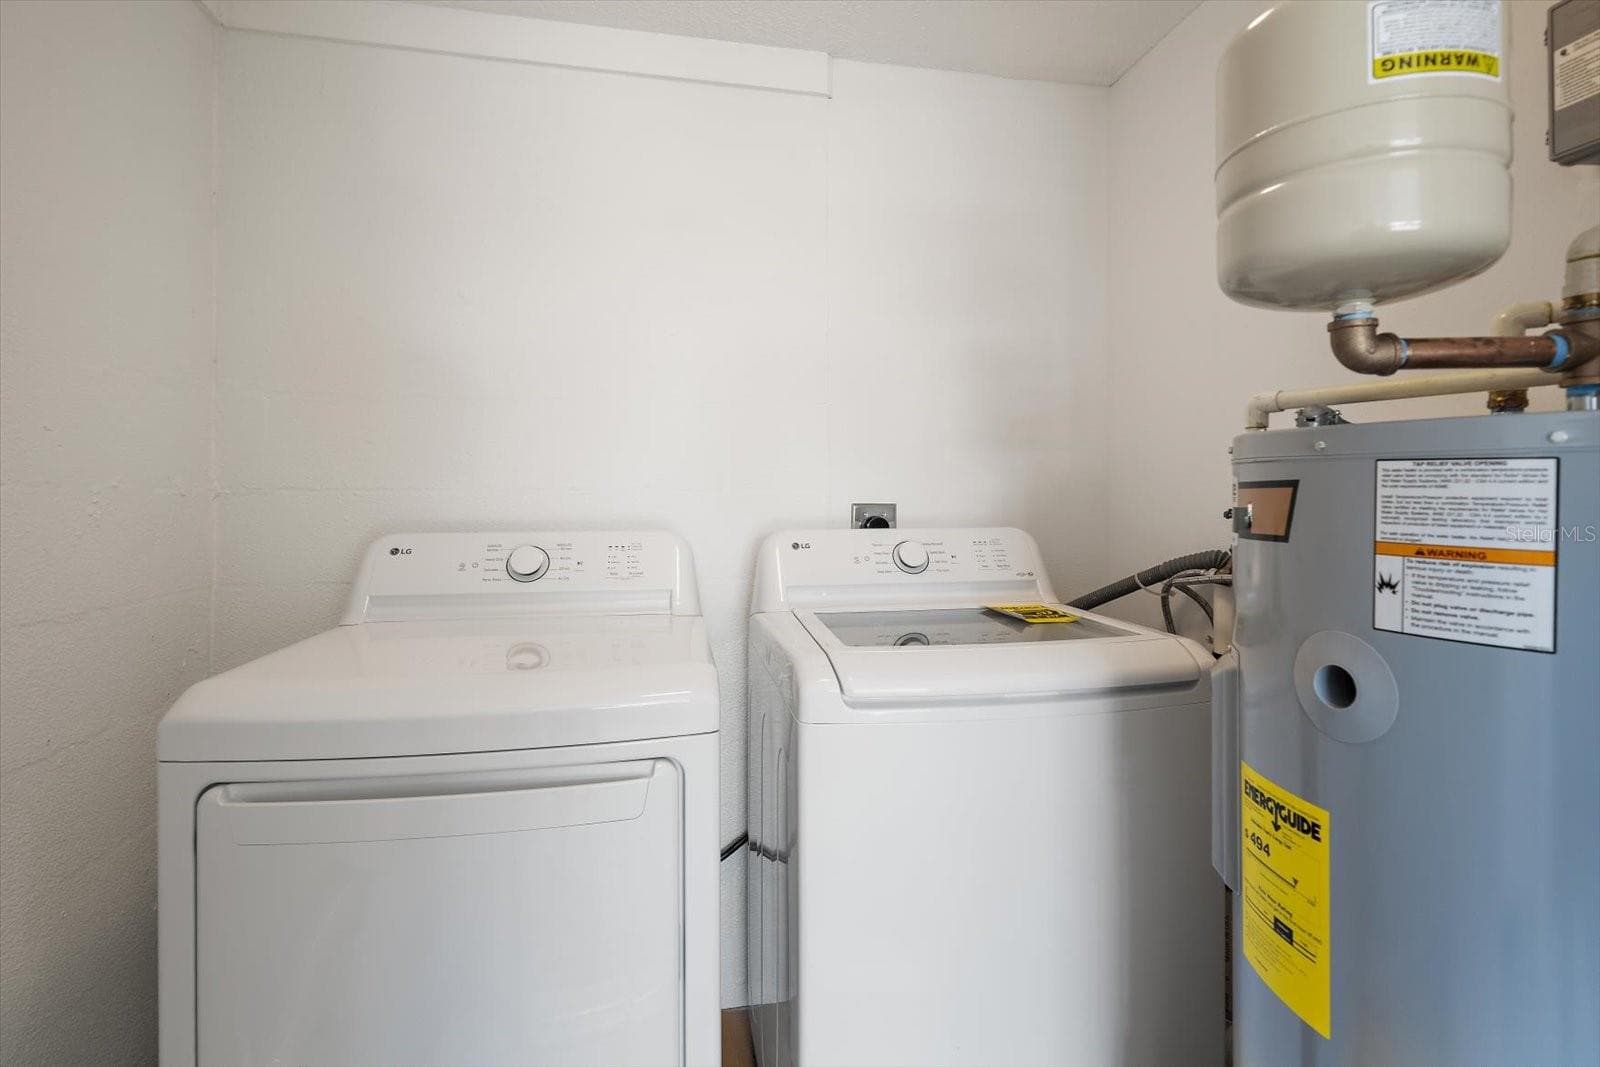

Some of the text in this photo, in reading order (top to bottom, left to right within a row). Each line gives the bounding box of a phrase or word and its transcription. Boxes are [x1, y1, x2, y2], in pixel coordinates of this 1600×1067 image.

[1381, 53, 1480, 72] WARNING
[1426, 549, 1487, 560] WARNING
[1244, 778, 1322, 843] ENERGYGUIDE
[1250, 832, 1270, 857] 494
